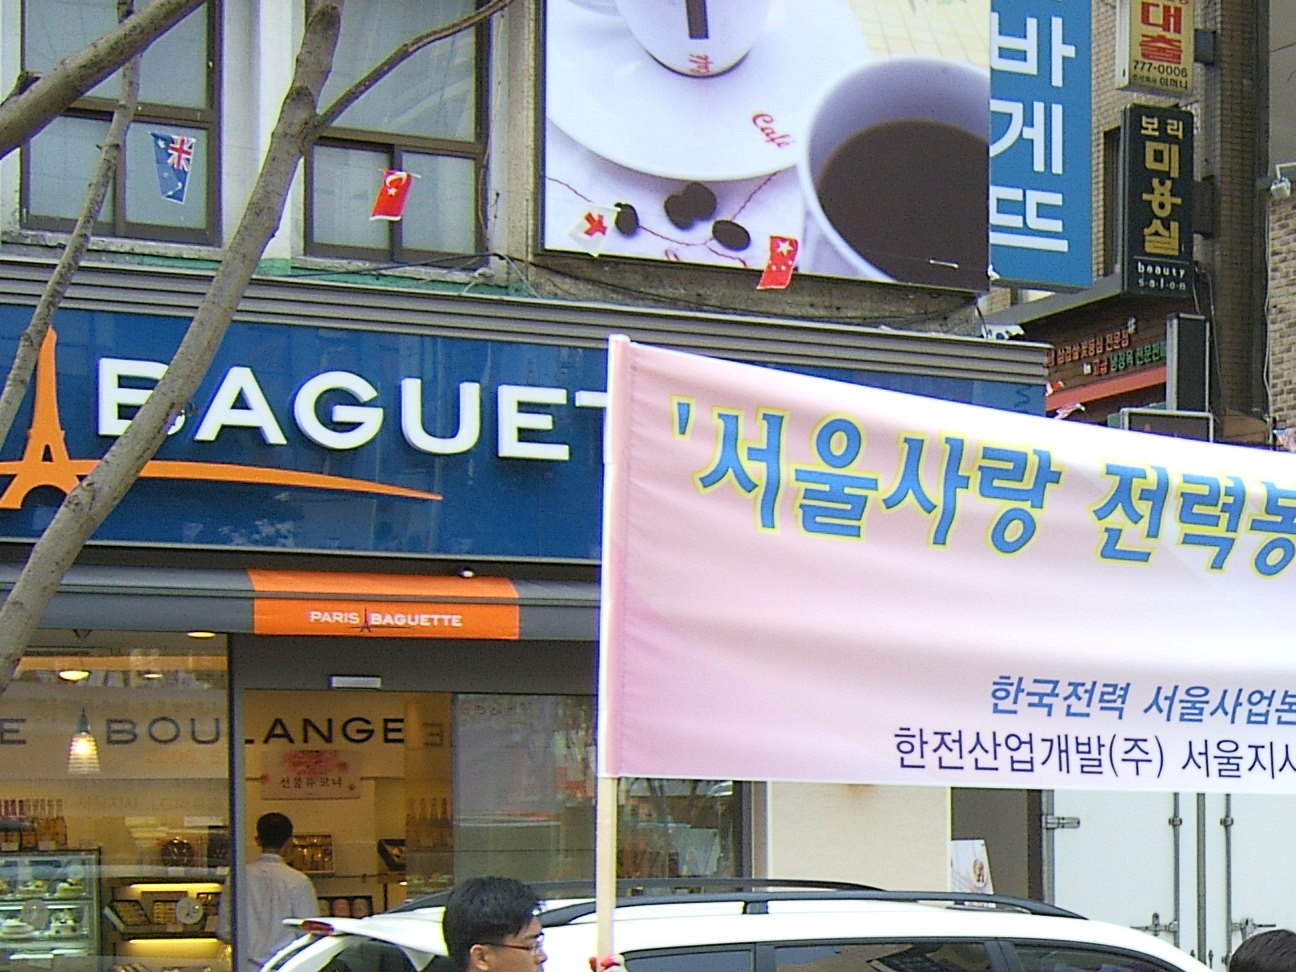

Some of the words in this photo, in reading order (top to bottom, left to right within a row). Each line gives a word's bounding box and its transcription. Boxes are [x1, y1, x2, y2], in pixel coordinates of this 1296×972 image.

[1138, 2, 1184, 65] 대출
[989, 11, 1077, 253] 바게뜨
[1140, 115, 1184, 140] 보리
[1141, 140, 1183, 257] 미용실
[1137, 260, 1186, 279] beauty
[97, 356, 609, 462] BAGUE
[308, 610, 359, 625] PARIS
[369, 611, 463, 628] BAGUETTE
[989, 674, 1131, 719] 한국전력
[106, 715, 405, 746] BOUANGE
[894, 726, 1165, 780] 한전산업개발(주)
